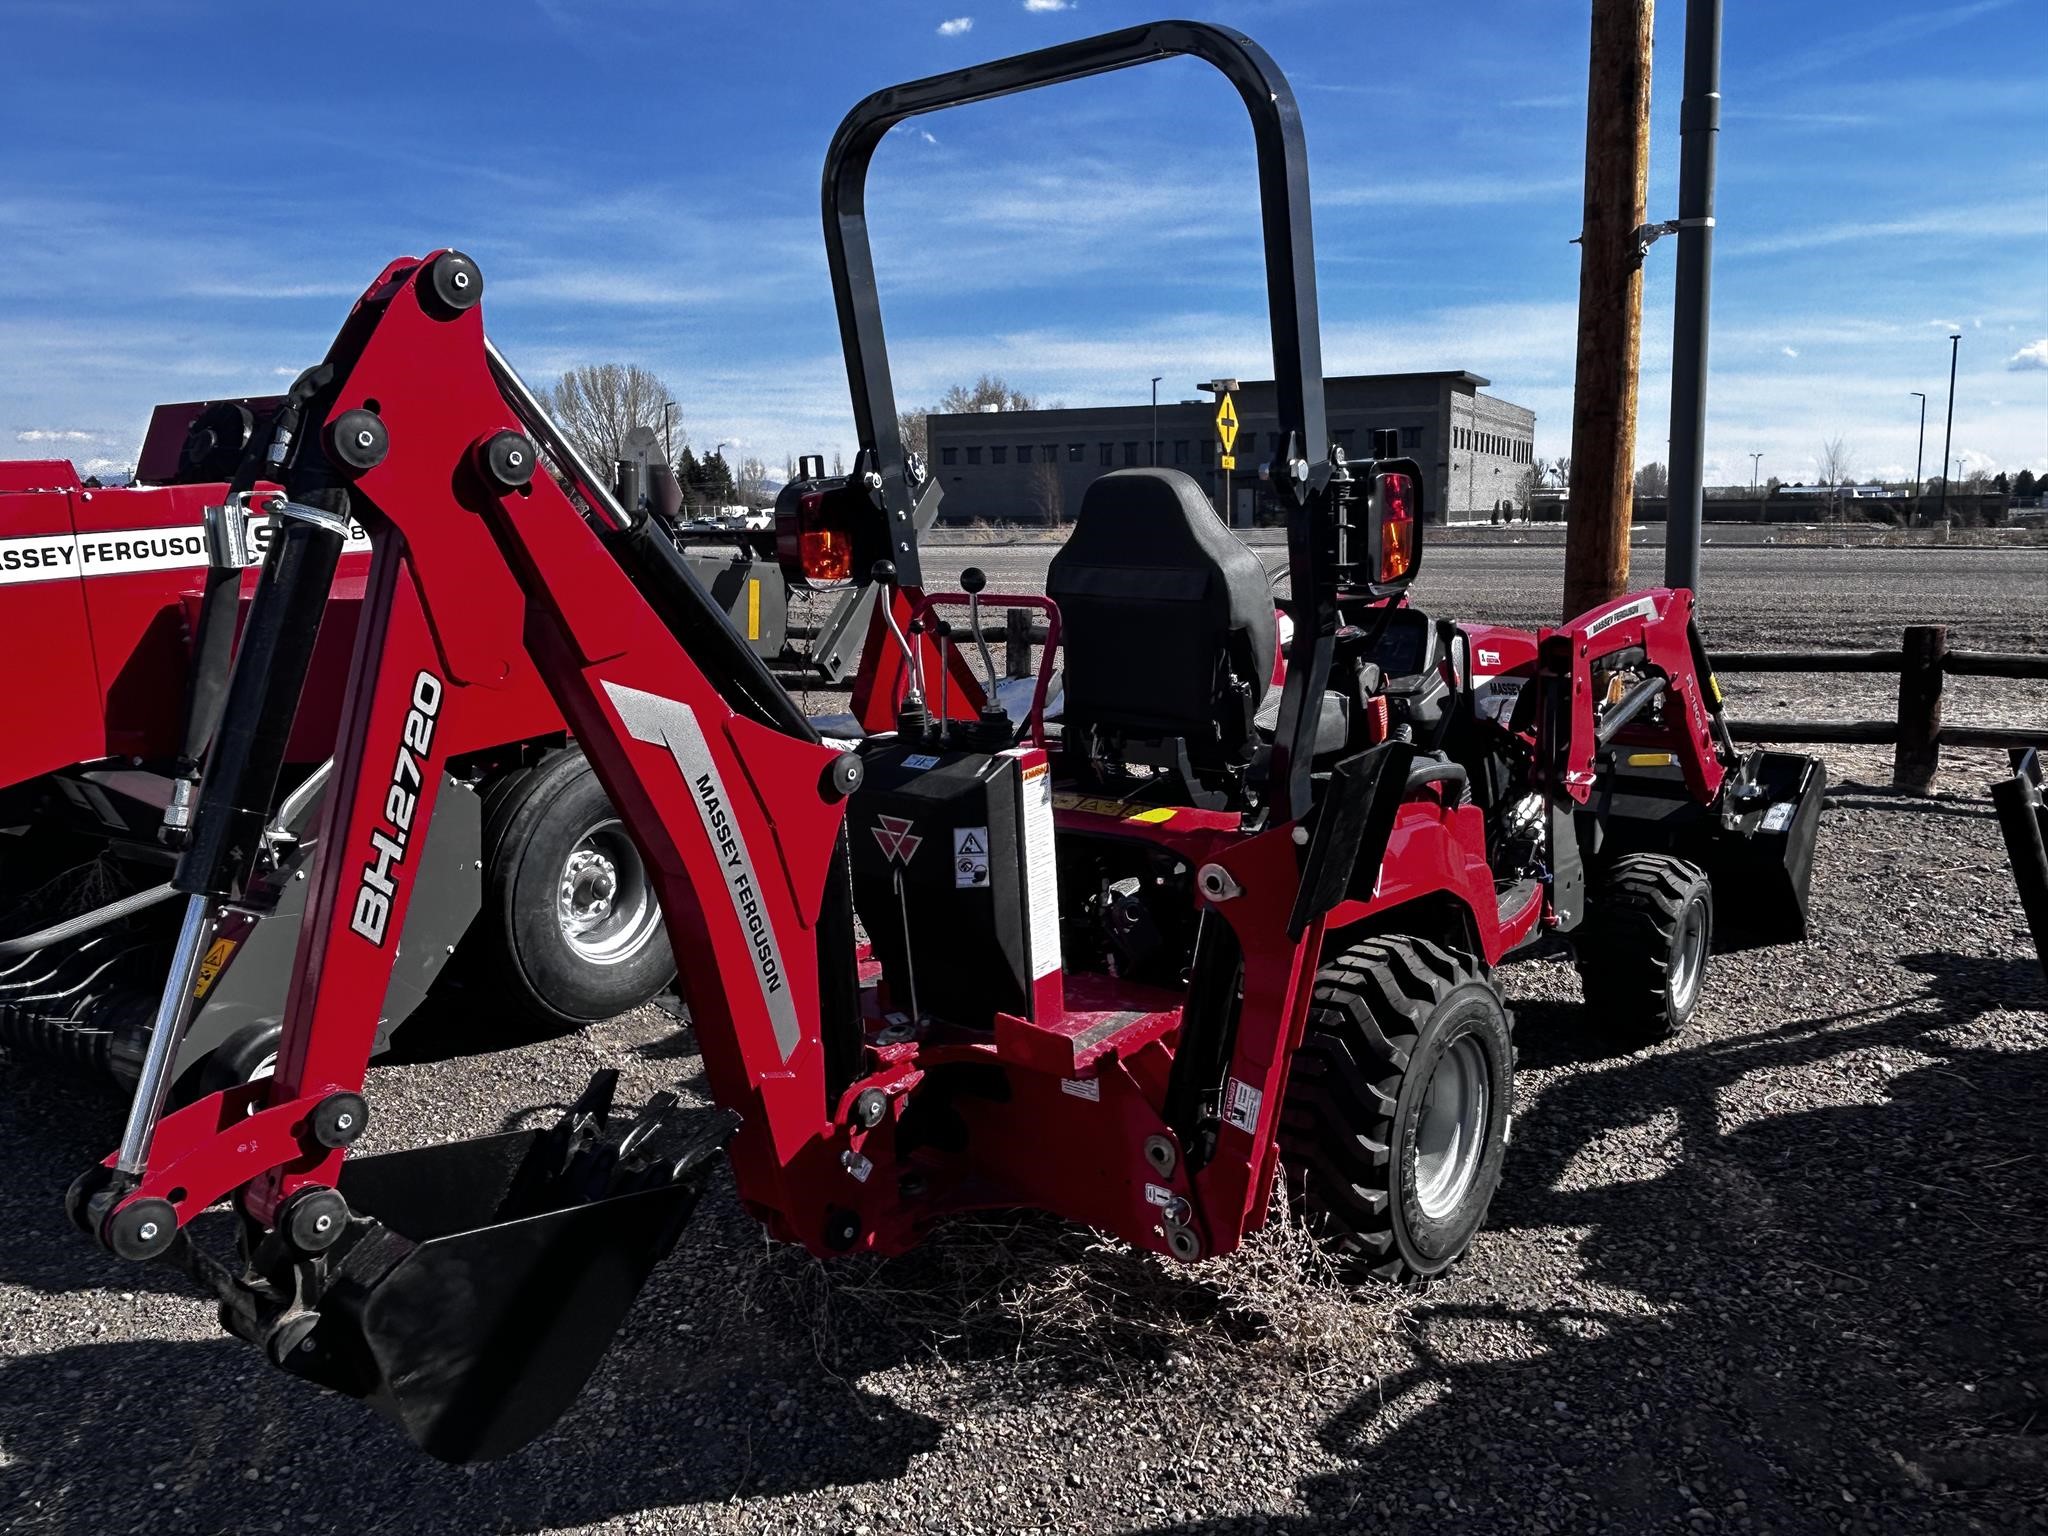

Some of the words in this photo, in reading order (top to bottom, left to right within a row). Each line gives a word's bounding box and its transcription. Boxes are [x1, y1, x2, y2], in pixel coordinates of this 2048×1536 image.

[0, 545, 74, 570] SSEY
[82, 536, 209, 563] FERGUSO
[351, 670, 442, 946] BH.2720
[696, 773, 742, 867] MASSEY
[734, 873, 781, 993] FERGUSON
